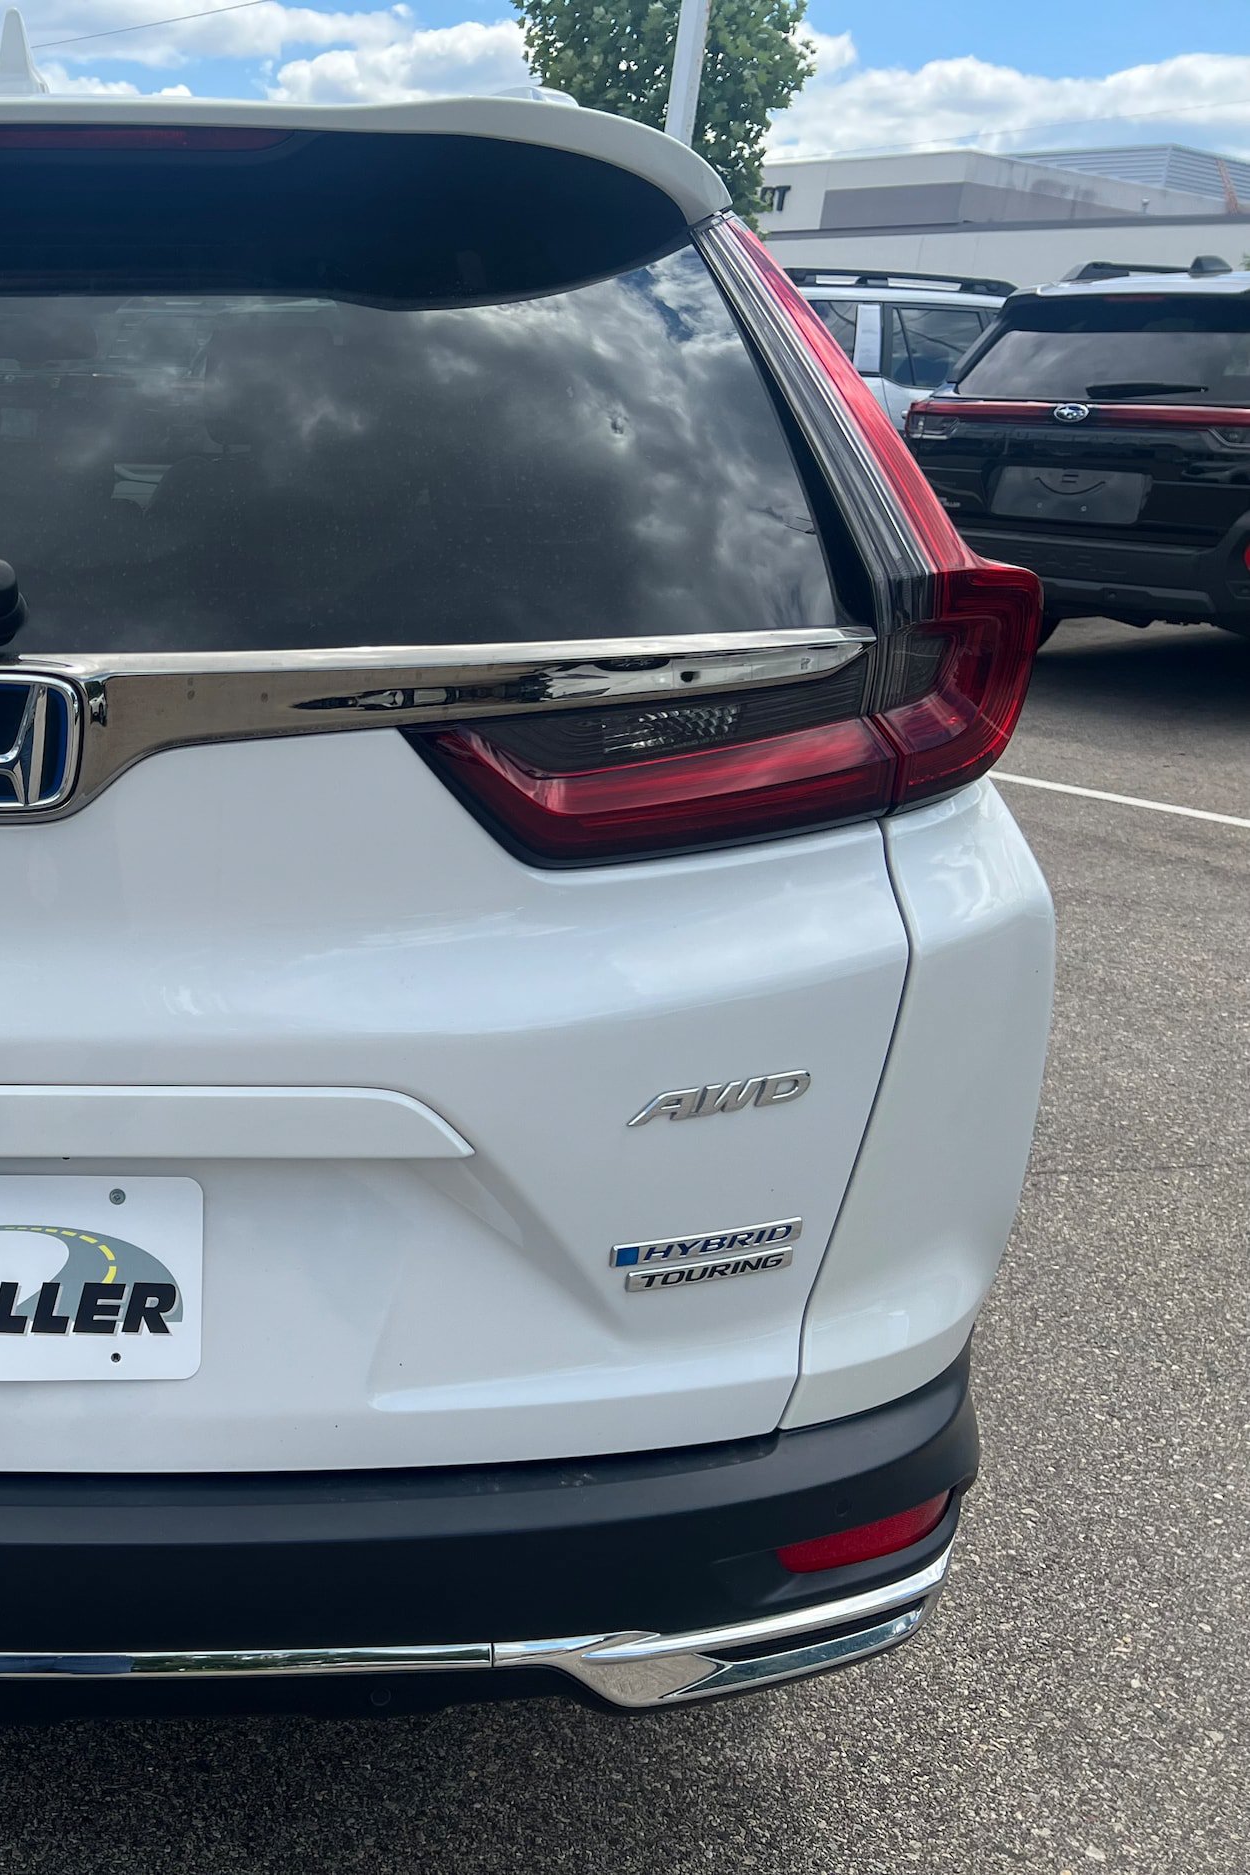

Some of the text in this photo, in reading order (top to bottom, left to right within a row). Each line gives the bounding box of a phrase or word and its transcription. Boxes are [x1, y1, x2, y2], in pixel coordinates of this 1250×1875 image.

[627, 1069, 811, 1126] AWD
[643, 1225, 792, 1261] HYBRID
[641, 1252, 785, 1288] TOURING
